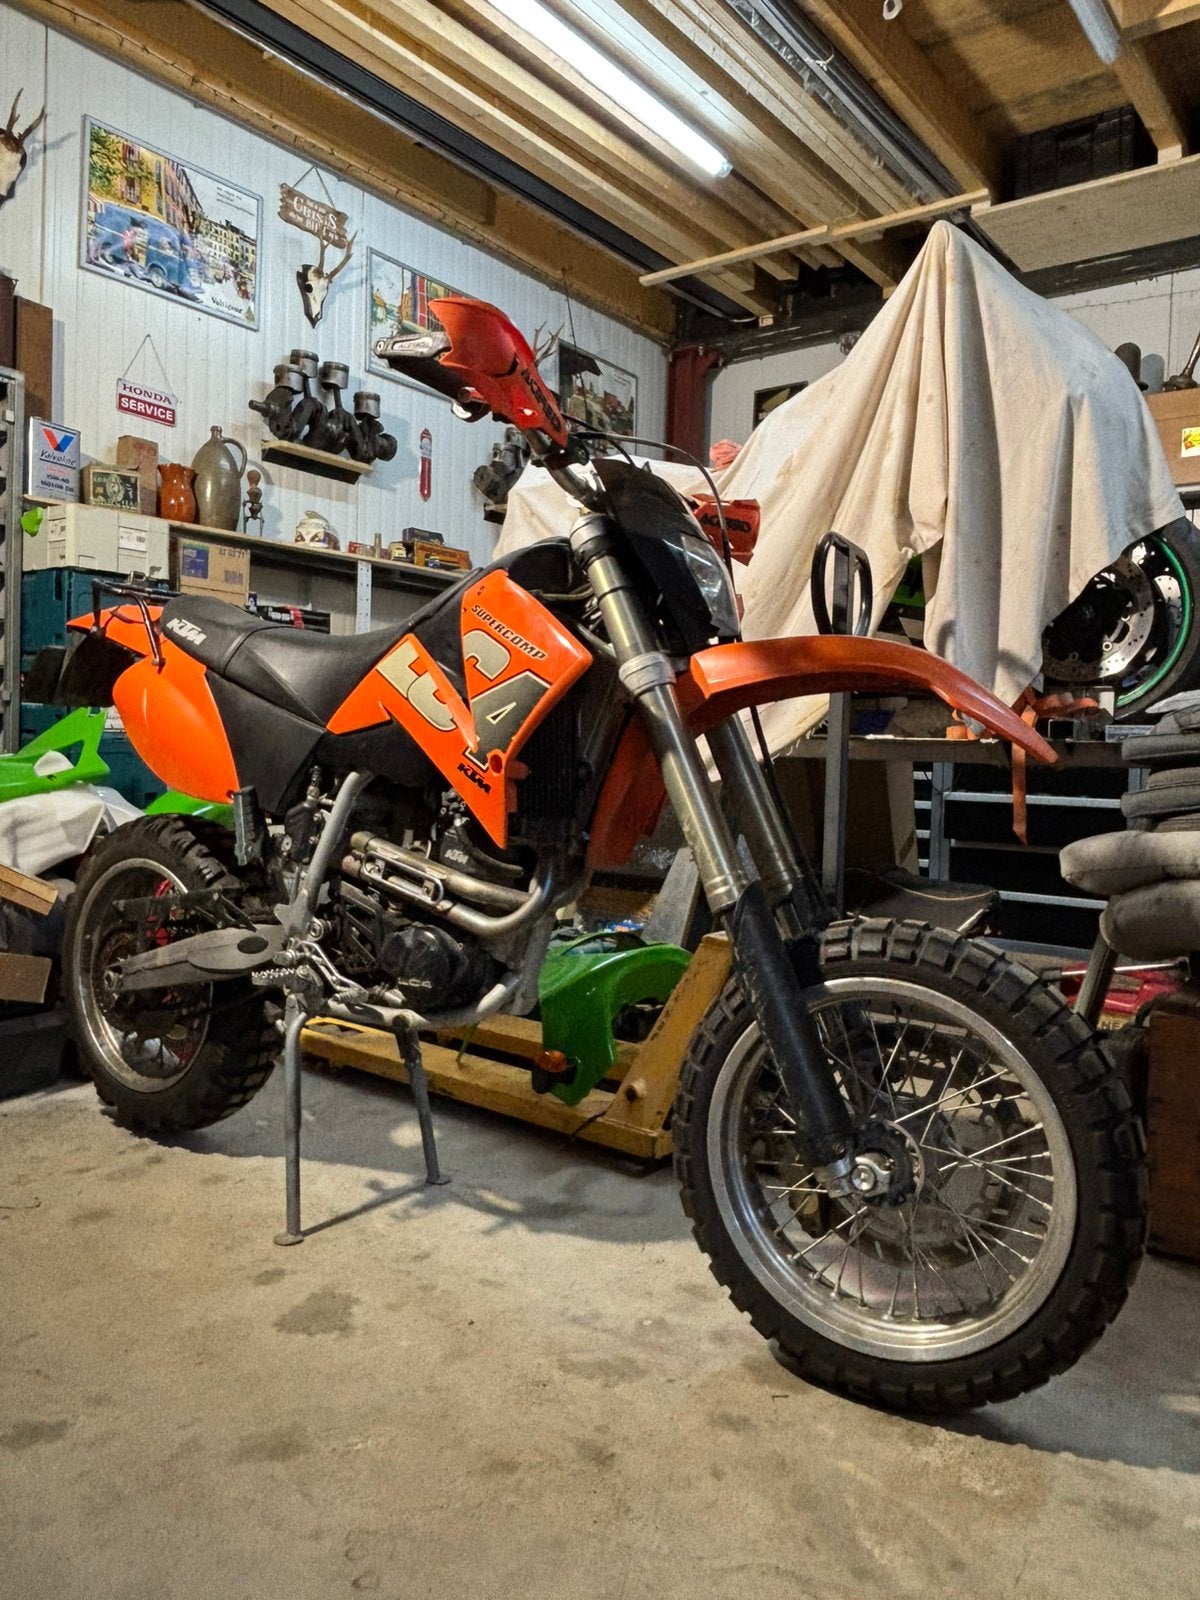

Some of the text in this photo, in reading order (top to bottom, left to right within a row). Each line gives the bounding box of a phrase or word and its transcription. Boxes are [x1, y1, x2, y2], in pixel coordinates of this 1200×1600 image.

[121, 382, 173, 406] HONDA
[120, 397, 174, 421] SERVICE
[40, 449, 77, 467] Valvoline
[166, 617, 208, 646] KTM
[471, 604, 548, 660] SUPERCOMP
[457, 762, 492, 795] KTM
[444, 848, 469, 865] KTM
